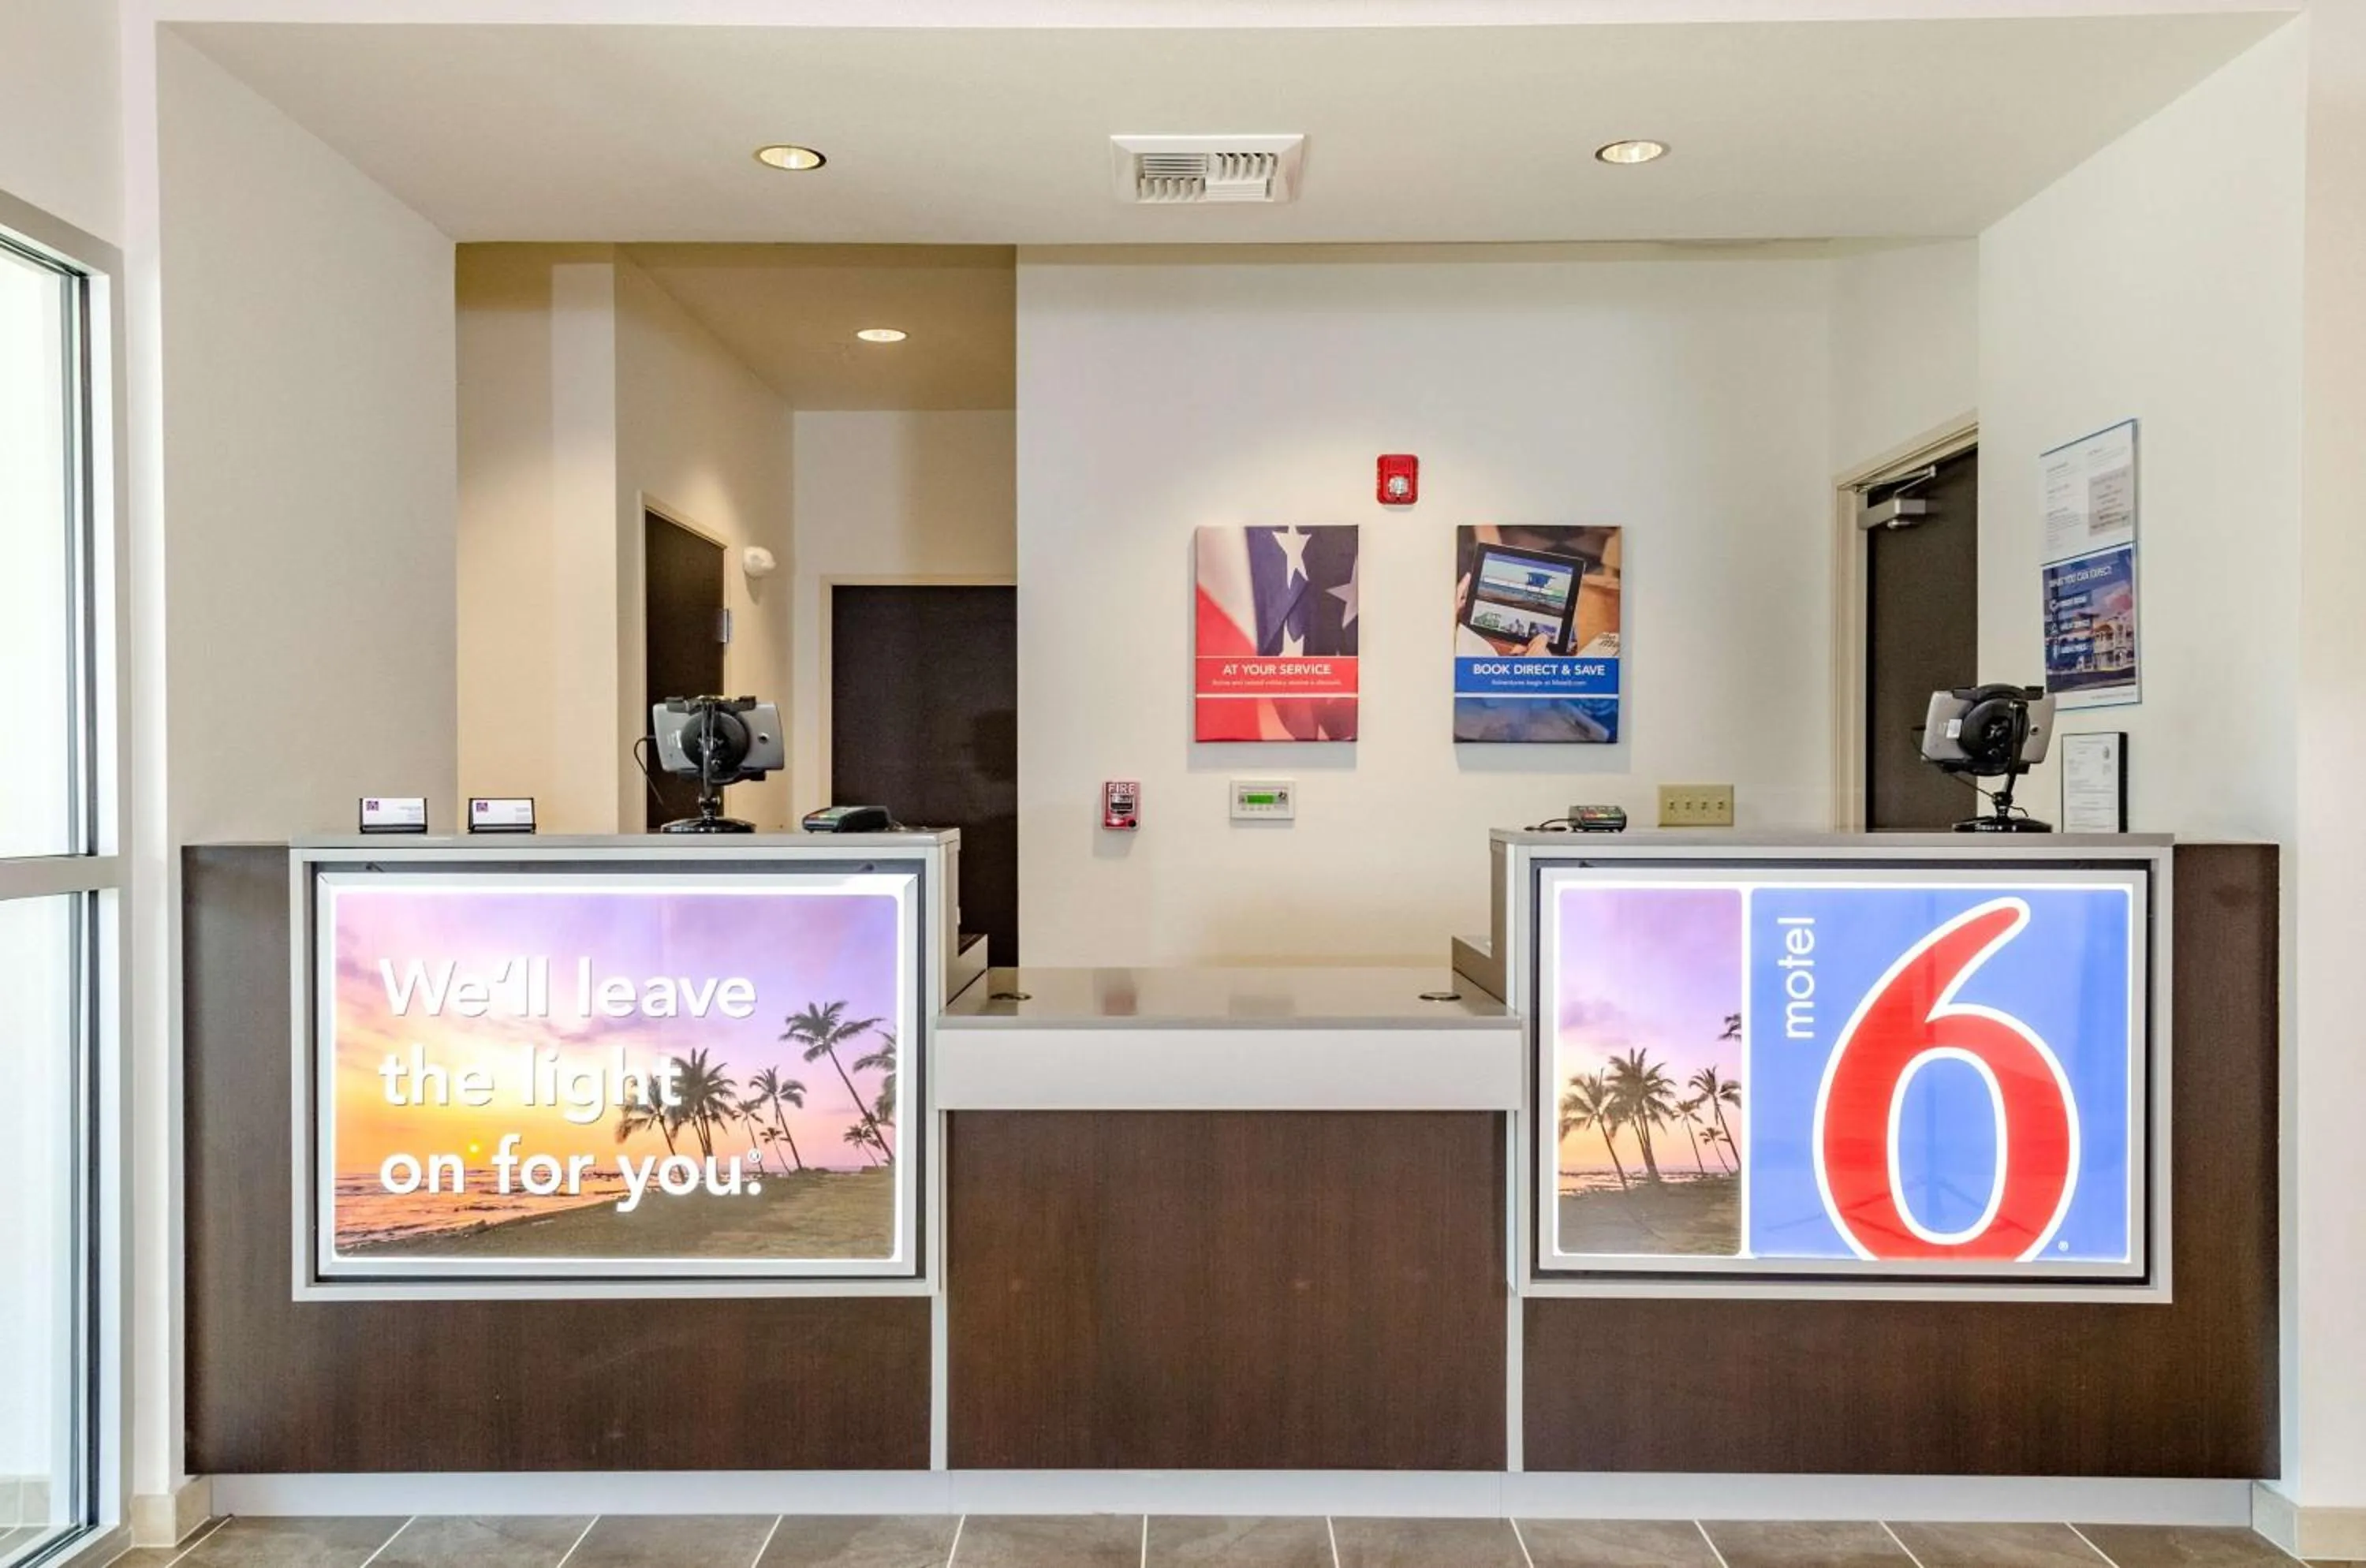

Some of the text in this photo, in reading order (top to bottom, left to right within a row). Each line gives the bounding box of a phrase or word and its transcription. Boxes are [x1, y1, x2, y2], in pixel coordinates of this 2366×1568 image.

[1223, 663, 1331, 675] AT YOUR SERVICE
[1472, 663, 1606, 676] BOOK DIRECT & SAVE
[1108, 783, 1136, 793] FIRE
[379, 957, 756, 1017] We'll leave
[1777, 917, 1815, 1038] motel
[379, 1044, 681, 1124] the light
[1812, 897, 2080, 1262] 6
[380, 1152, 465, 1194] on
[492, 1133, 595, 1195] for
